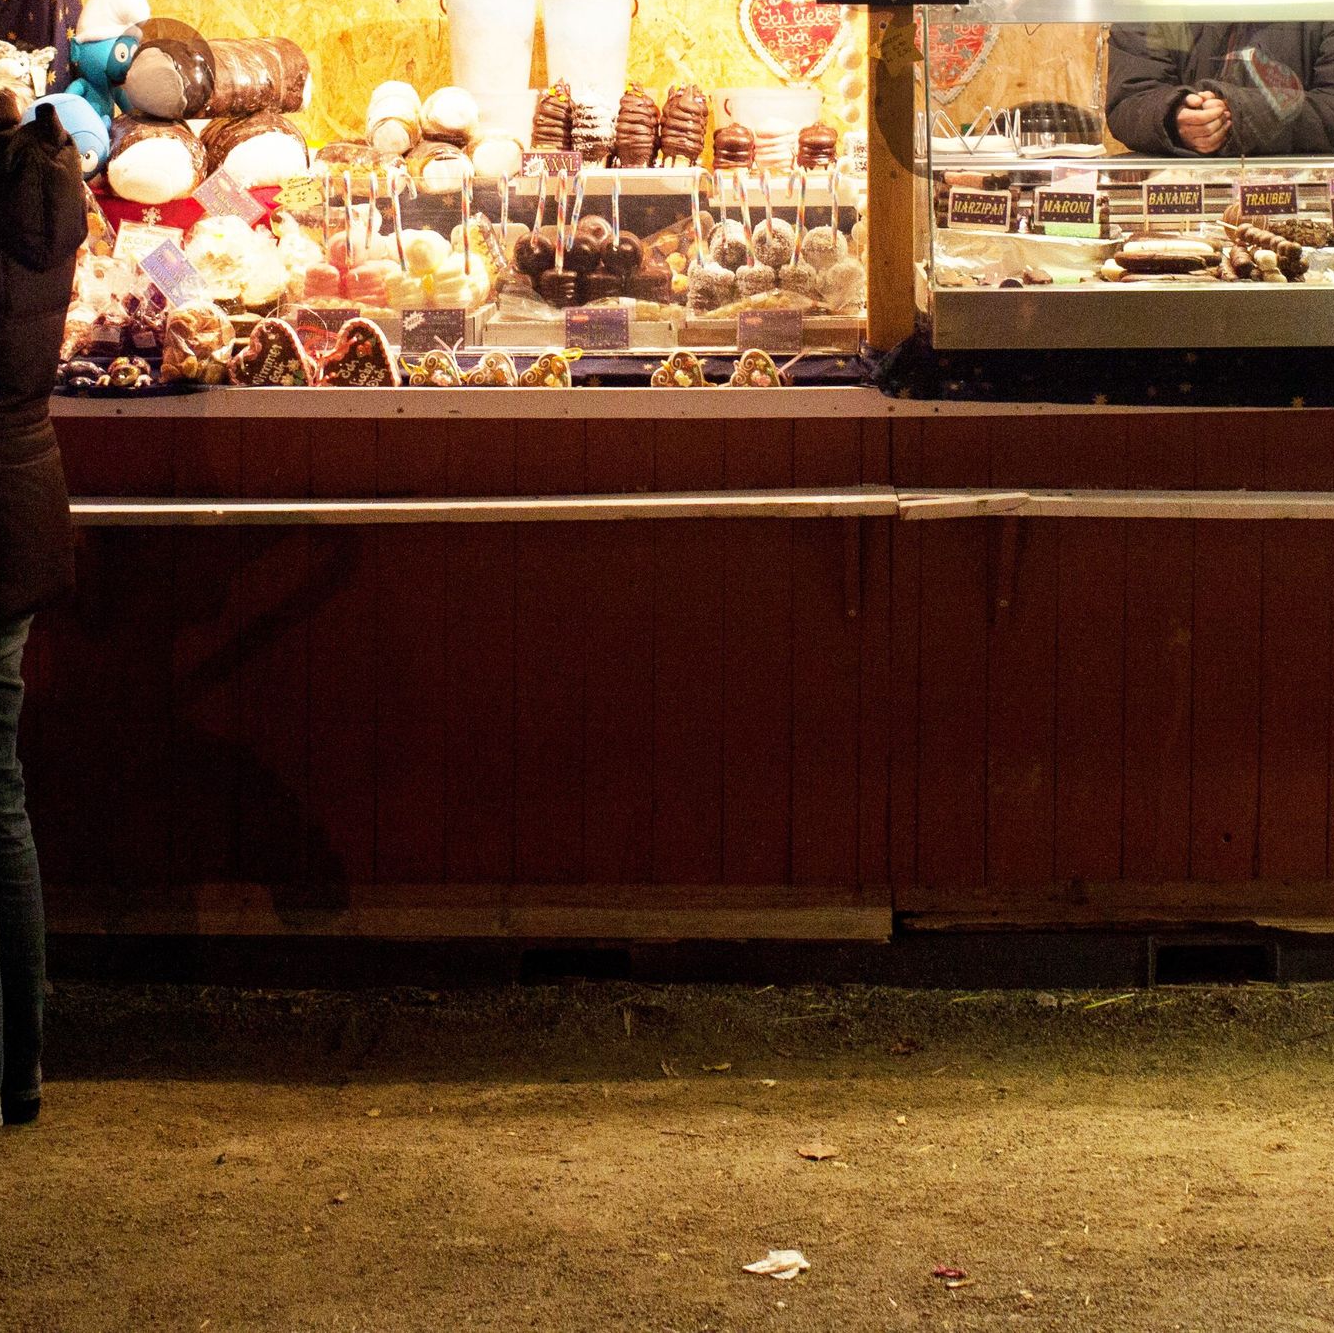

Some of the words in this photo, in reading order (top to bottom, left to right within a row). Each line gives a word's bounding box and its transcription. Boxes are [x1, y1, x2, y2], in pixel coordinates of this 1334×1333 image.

[757, 9, 788, 27] Ich
[791, 5, 834, 26] liebe
[775, 28, 812, 46] Dich
[1148, 191, 1200, 206] BANANEN
[1245, 191, 1292, 207] TRAUBEN
[953, 200, 1006, 215] MARZIPAN
[1041, 200, 1091, 214] MARONI
